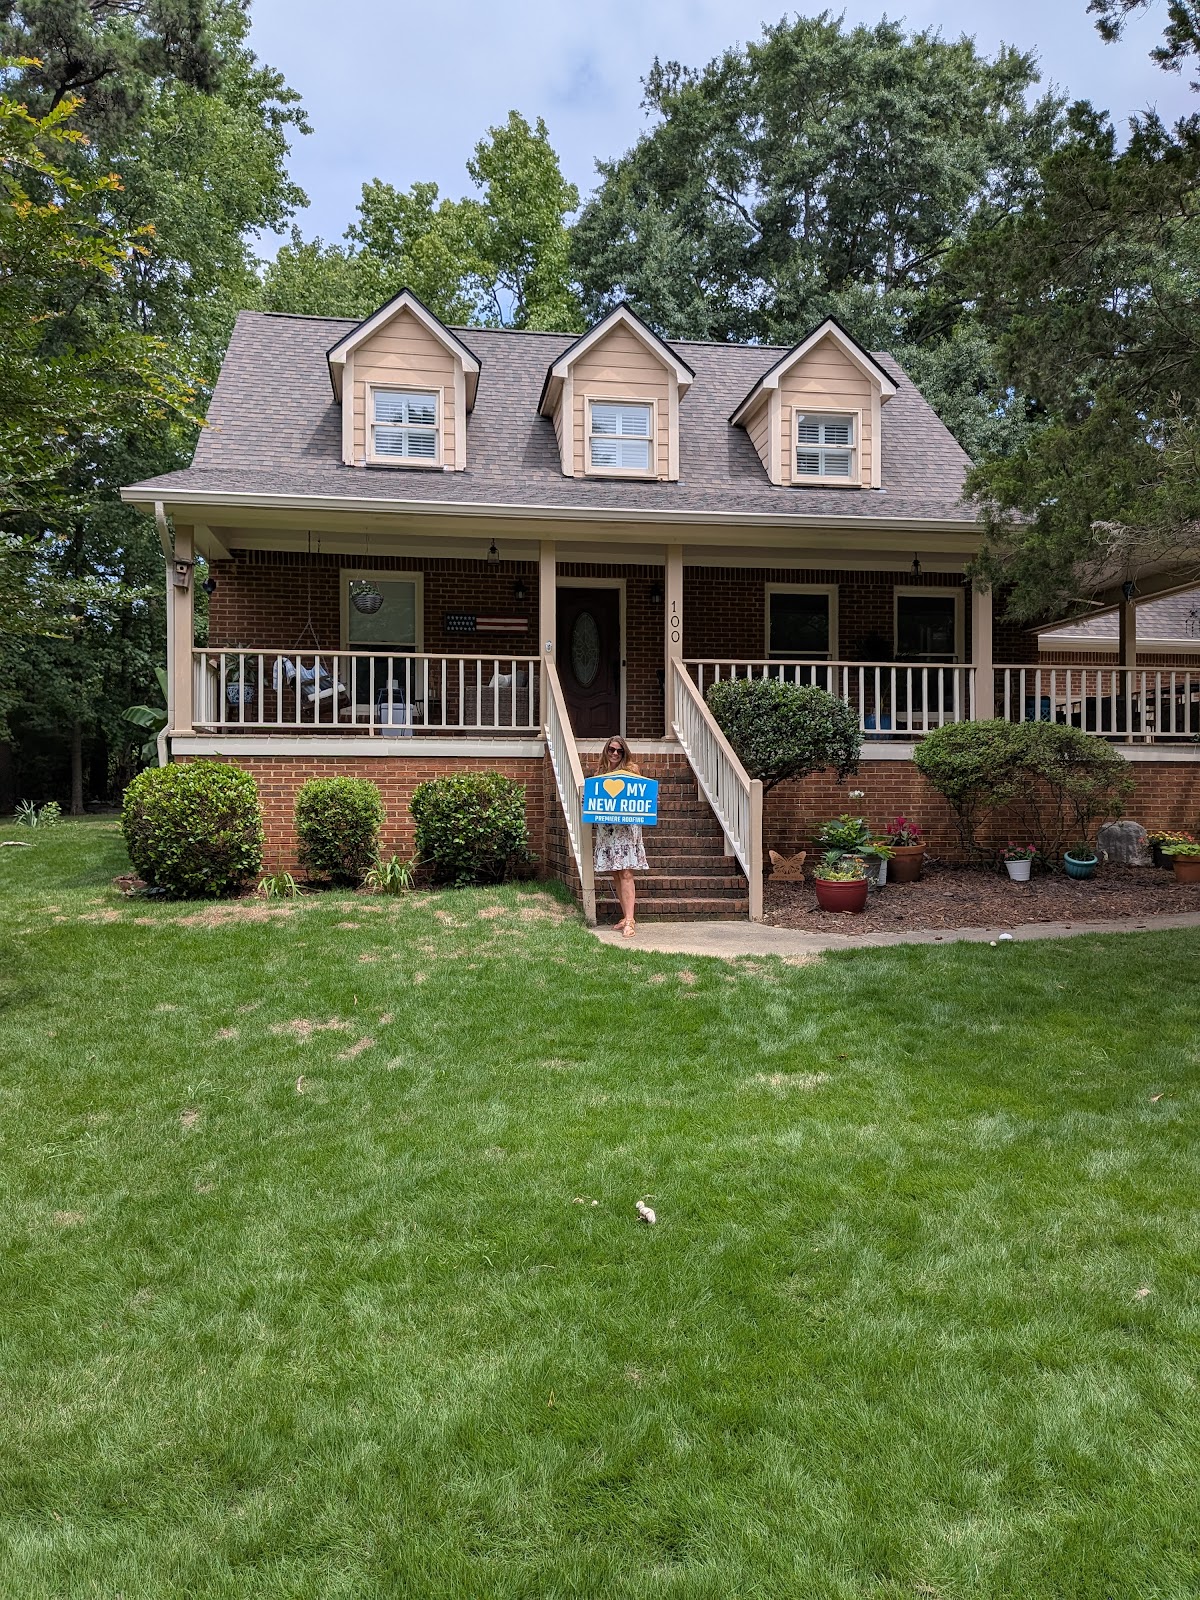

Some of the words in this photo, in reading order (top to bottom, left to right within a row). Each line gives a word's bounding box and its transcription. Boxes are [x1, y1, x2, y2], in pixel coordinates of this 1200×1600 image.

[671, 600, 680, 643] 100
[594, 782, 599, 796] I
[626, 783, 647, 797] MY
[588, 798, 617, 812] NEW
[620, 799, 652, 813] ROOF
[594, 815, 621, 823] PREMIERE
